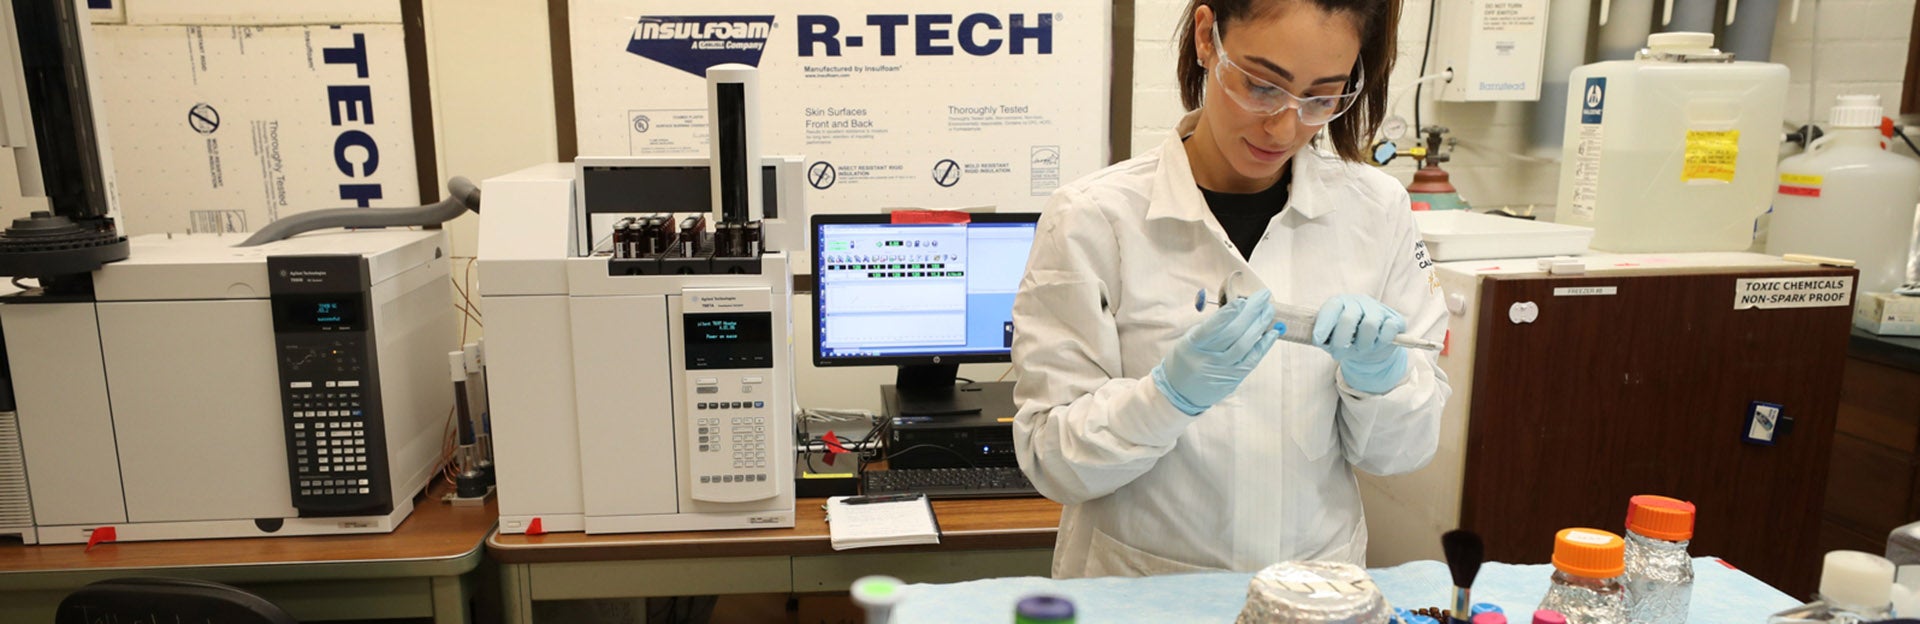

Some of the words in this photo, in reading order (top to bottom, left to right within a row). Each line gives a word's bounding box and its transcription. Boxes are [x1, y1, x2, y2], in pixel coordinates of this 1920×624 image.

[691, 41, 697, 49] A
[725, 41, 764, 50] Company
[1479, 81, 1525, 91] Barnstead
[805, 107, 825, 116] Skin
[828, 107, 867, 116] Surfaces
[948, 105, 997, 115] Thoroughly
[1000, 104, 1029, 114] Tested
[805, 119, 829, 128] Front
[832, 119, 849, 128] and
[851, 119, 873, 128] Back
[269, 121, 282, 173] Thoroughly
[276, 175, 288, 206] Tested
[1745, 282, 1780, 291] TOXIC
[1783, 280, 1844, 290] CHEMICALS
[1741, 293, 1807, 304] NON-SPARK
[1808, 292, 1845, 302] PROOF
